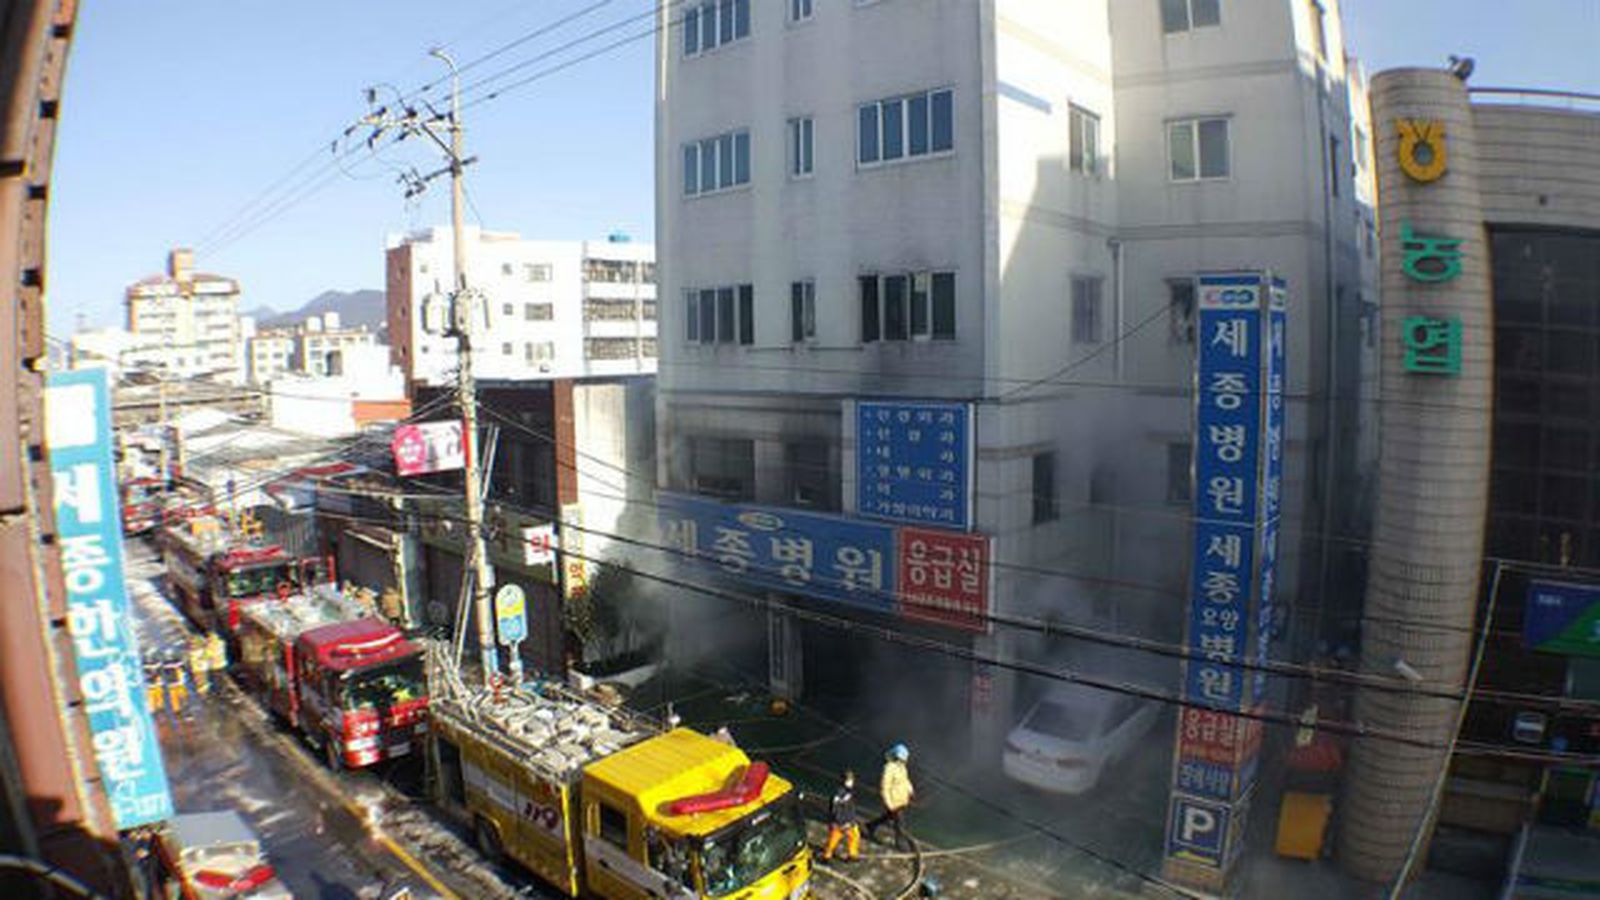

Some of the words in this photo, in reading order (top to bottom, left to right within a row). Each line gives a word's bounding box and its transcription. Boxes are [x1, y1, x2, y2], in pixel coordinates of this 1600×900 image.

[1401, 219, 1464, 376] 농협
[1207, 318, 1249, 514] 세종병원
[665, 519, 882, 592] 세종병원
[906, 539, 981, 594] 응급실
[1186, 709, 1235, 748] 응급실
[525, 801, 559, 829] 119
[1183, 806, 1215, 840] P
